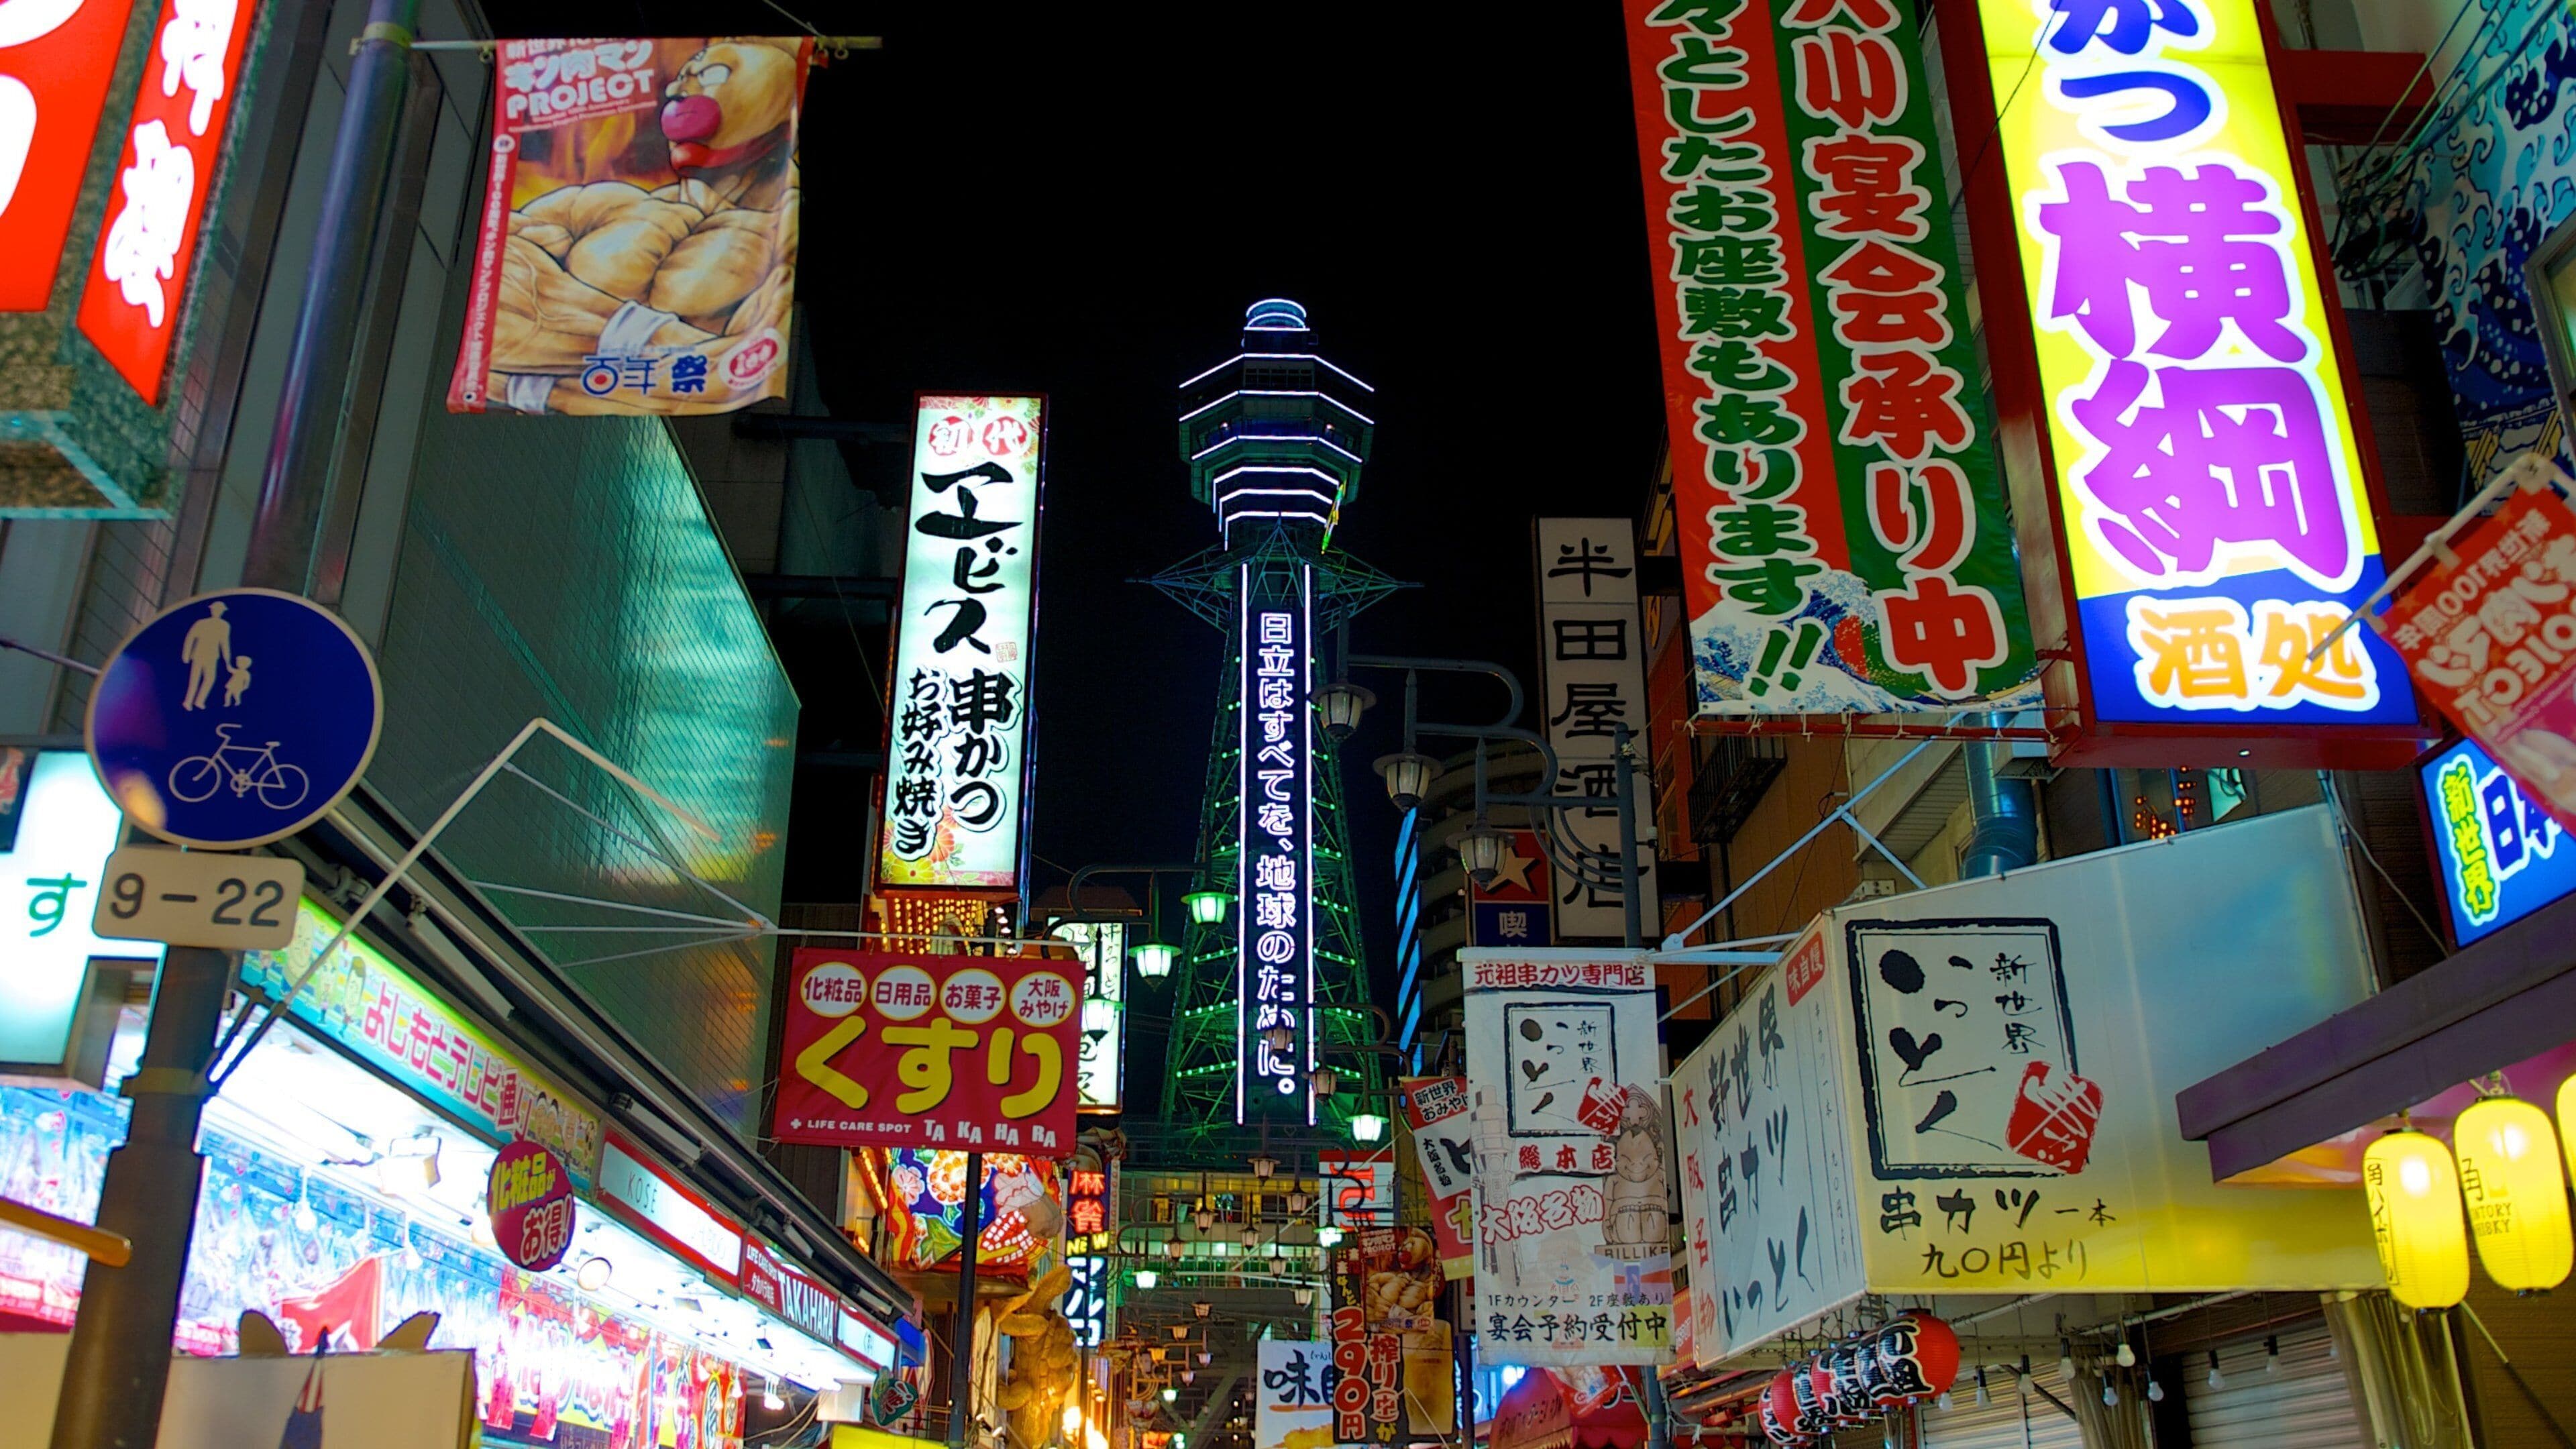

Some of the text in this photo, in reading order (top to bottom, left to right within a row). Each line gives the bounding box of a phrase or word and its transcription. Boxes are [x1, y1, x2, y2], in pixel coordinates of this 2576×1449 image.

[506, 68, 655, 119] PROJECT
[914, 461, 1024, 654] エビス
[2139, 607, 2368, 699] 酒処
[894, 668, 942, 854] お好み焼き
[949, 668, 1014, 825] 串かつ
[2443, 765, 2494, 914] 新世界
[1499, 912, 1527, 947] 喫
[804, 975, 1061, 1011] 化粧品 日用品 お菓子 大阪
[1020, 999, 1069, 1020] みやげ
[1474, 963, 1646, 987] 元祖串カツ専門店
[1990, 952, 2046, 1055] 新世界
[364, 981, 533, 1142] よしもとテレビ通り
[796, 1016, 1063, 1119] くすり
[1576, 1020, 1603, 1074] 新世界
[808, 1120, 836, 1130] LIFE
[840, 1121, 873, 1132] CARE
[877, 1123, 912, 1134] SPOT
[1415, 1081, 1456, 1106] 新世界
[1683, 1083, 1715, 1336] 大阪名物
[1717, 1104, 1789, 1242] 串カツ
[1066, 1232, 1109, 1256] NEW
[777, 1271, 835, 1344] TAKAHARA
[1486, 1310, 1667, 1342] 宴会予約受付中
[1334, 1307, 1371, 1440] 290円
